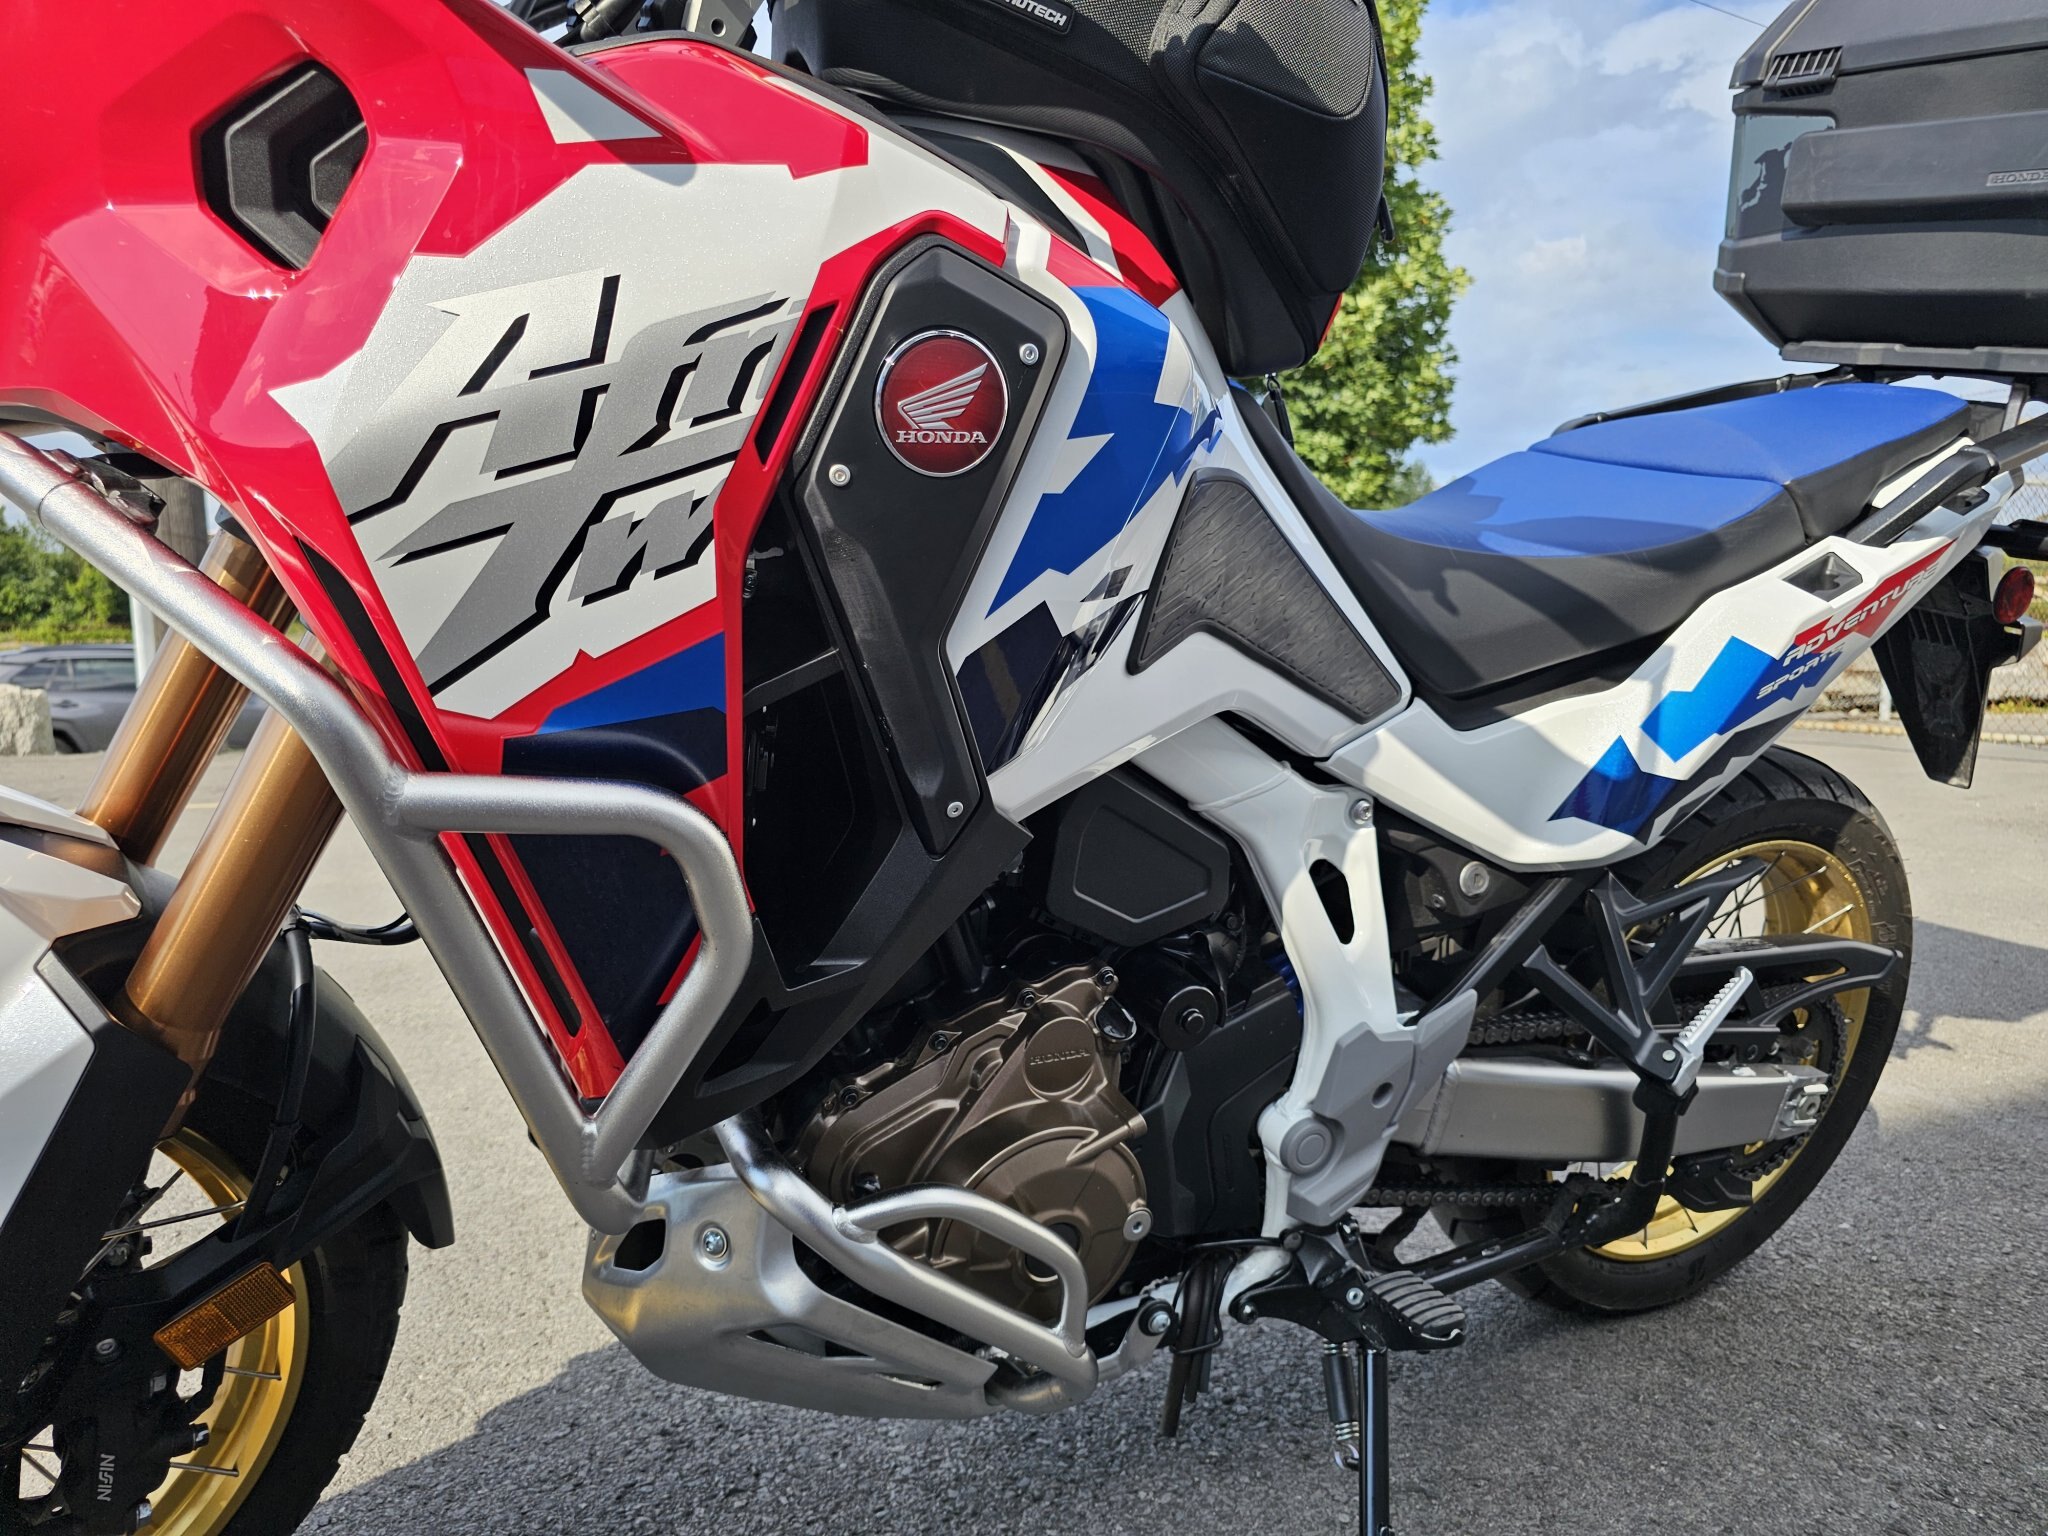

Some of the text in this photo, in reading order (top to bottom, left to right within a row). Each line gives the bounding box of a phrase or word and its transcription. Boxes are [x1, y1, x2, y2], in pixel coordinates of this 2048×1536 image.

[896, 430, 988, 444] HONDA
[1782, 561, 1939, 667] ADVENTURE
[1756, 642, 1846, 699] SPORTS
[1029, 1048, 1091, 1066] HONDA
